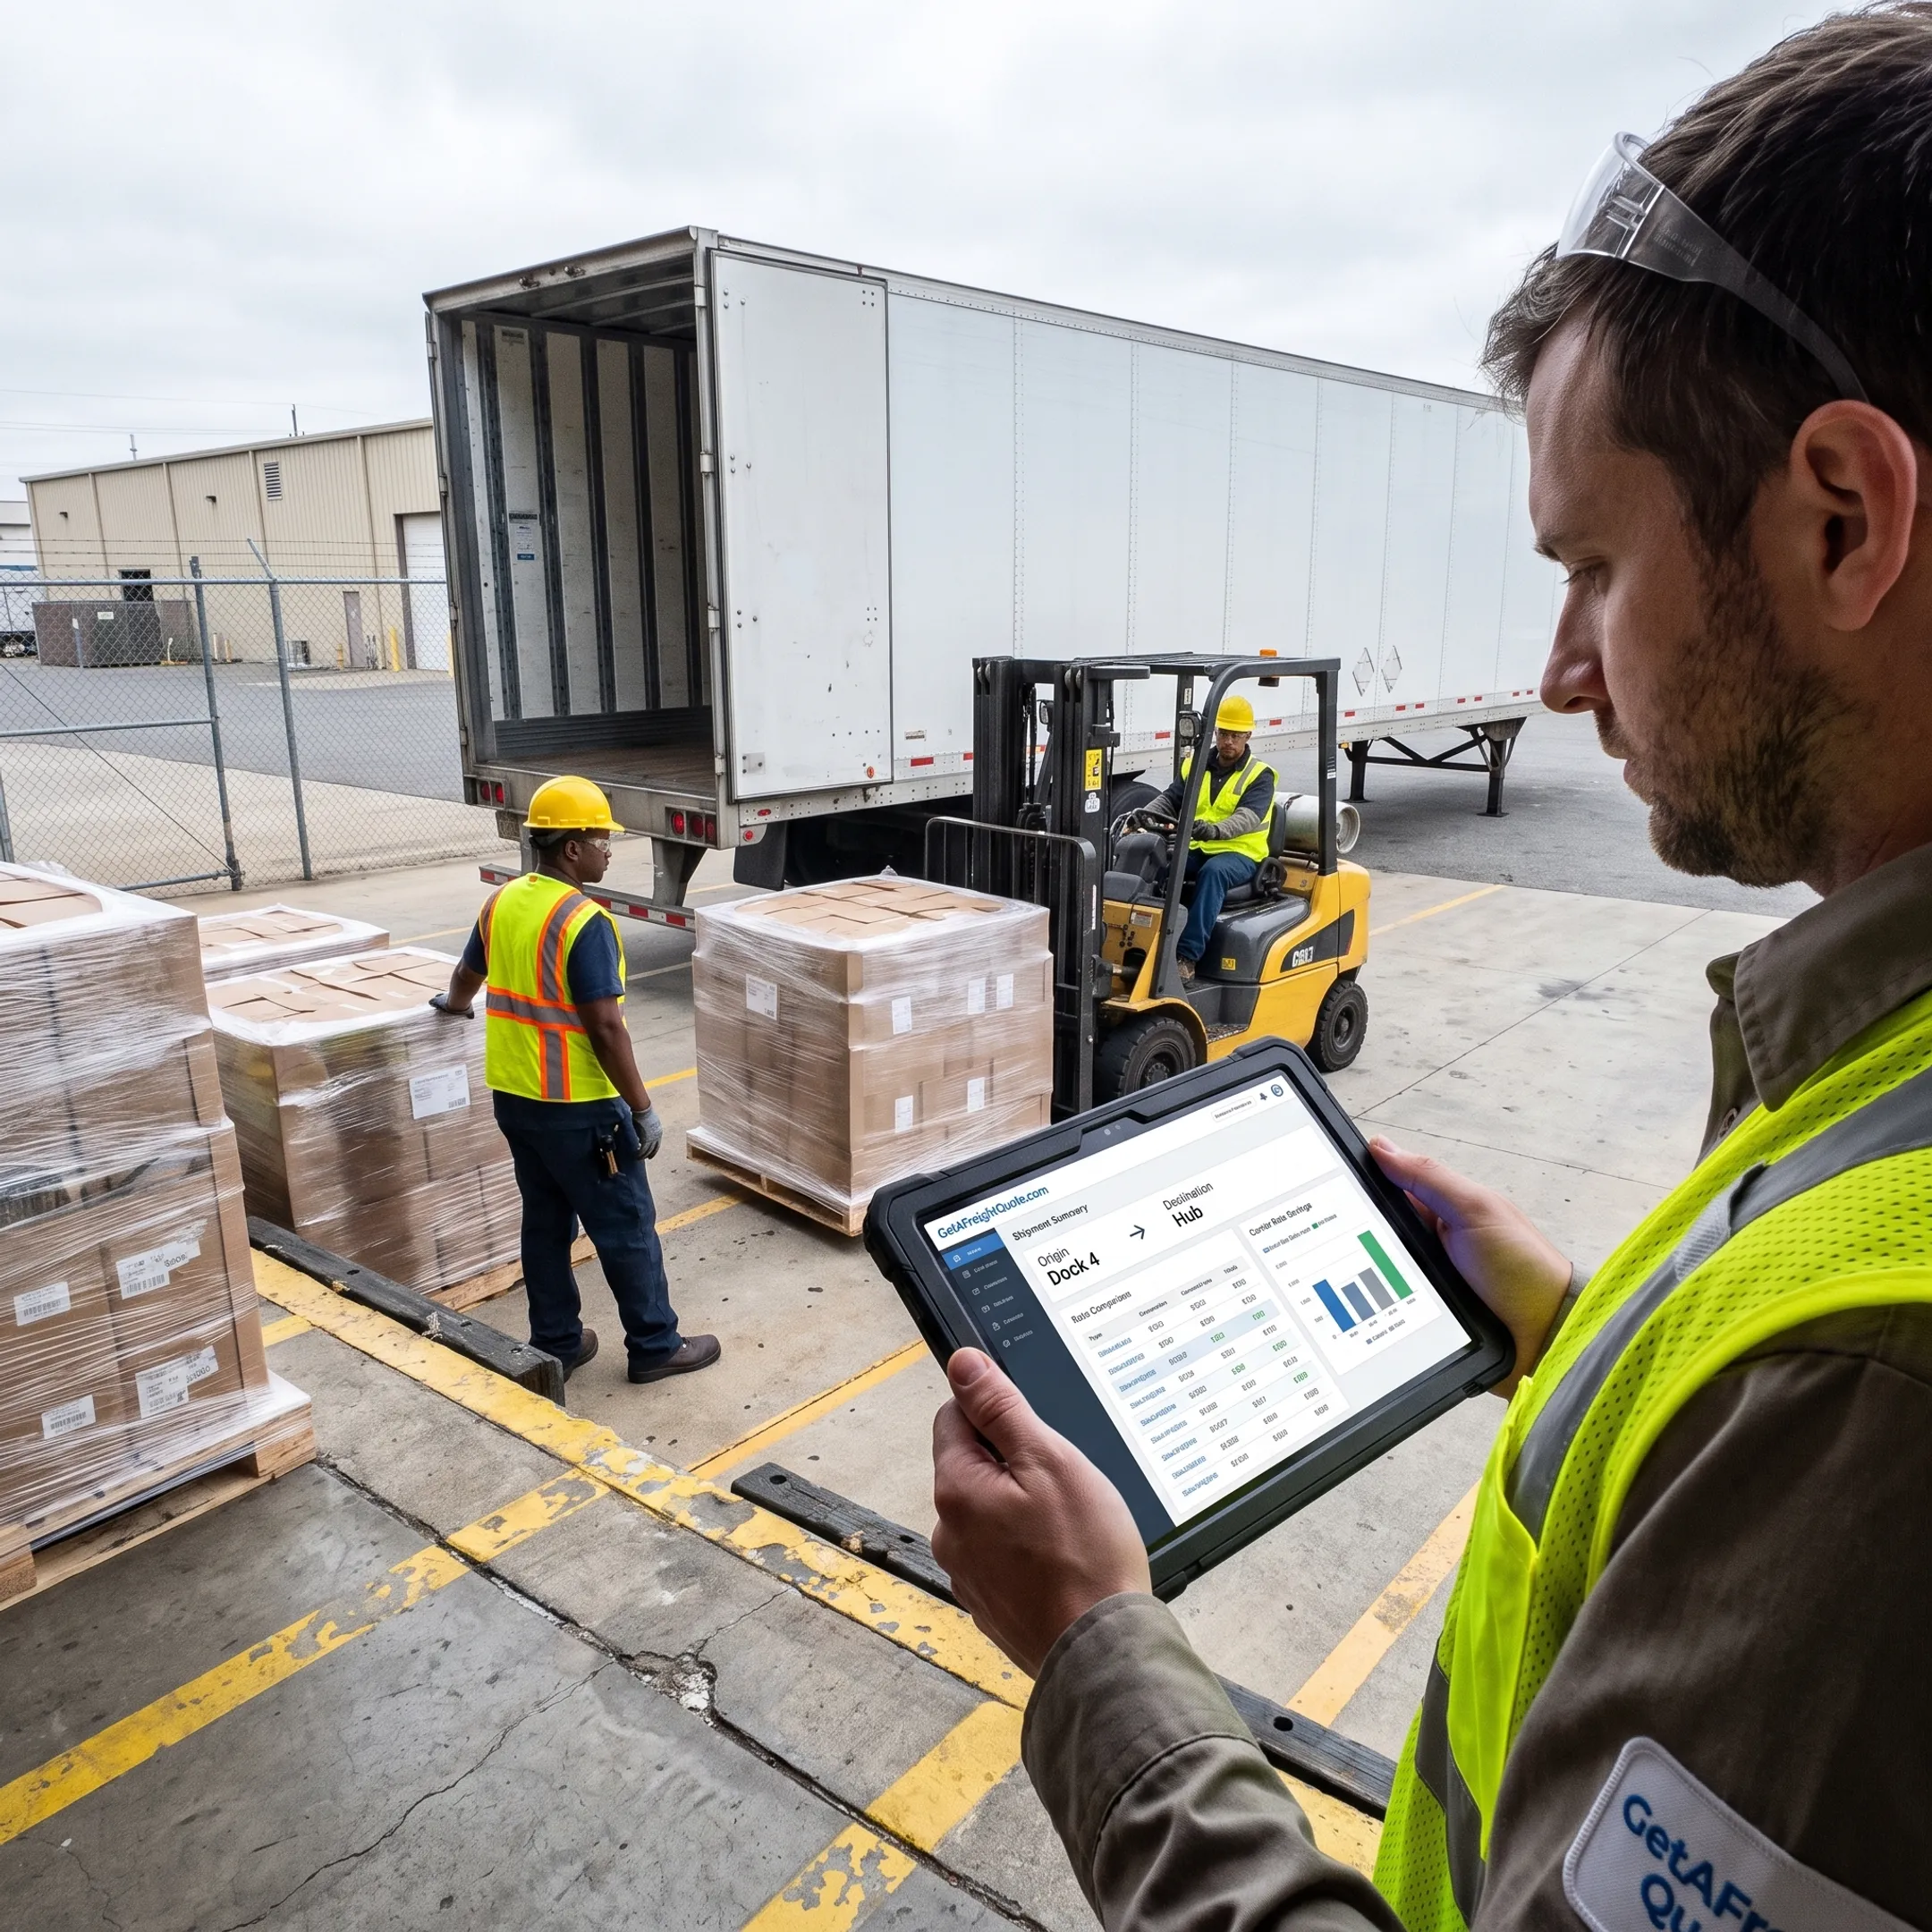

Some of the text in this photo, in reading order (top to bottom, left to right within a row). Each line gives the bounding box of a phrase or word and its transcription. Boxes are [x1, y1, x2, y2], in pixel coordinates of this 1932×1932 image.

[937, 1185, 1049, 1239] GetAFreightQuote.com
[1172, 1205, 1203, 1227] Hub
[1038, 1247, 1070, 1267] Origin
[1046, 1251, 1100, 1286] Dock 4
[1623, 1794, 1786, 1932] GetAFr
